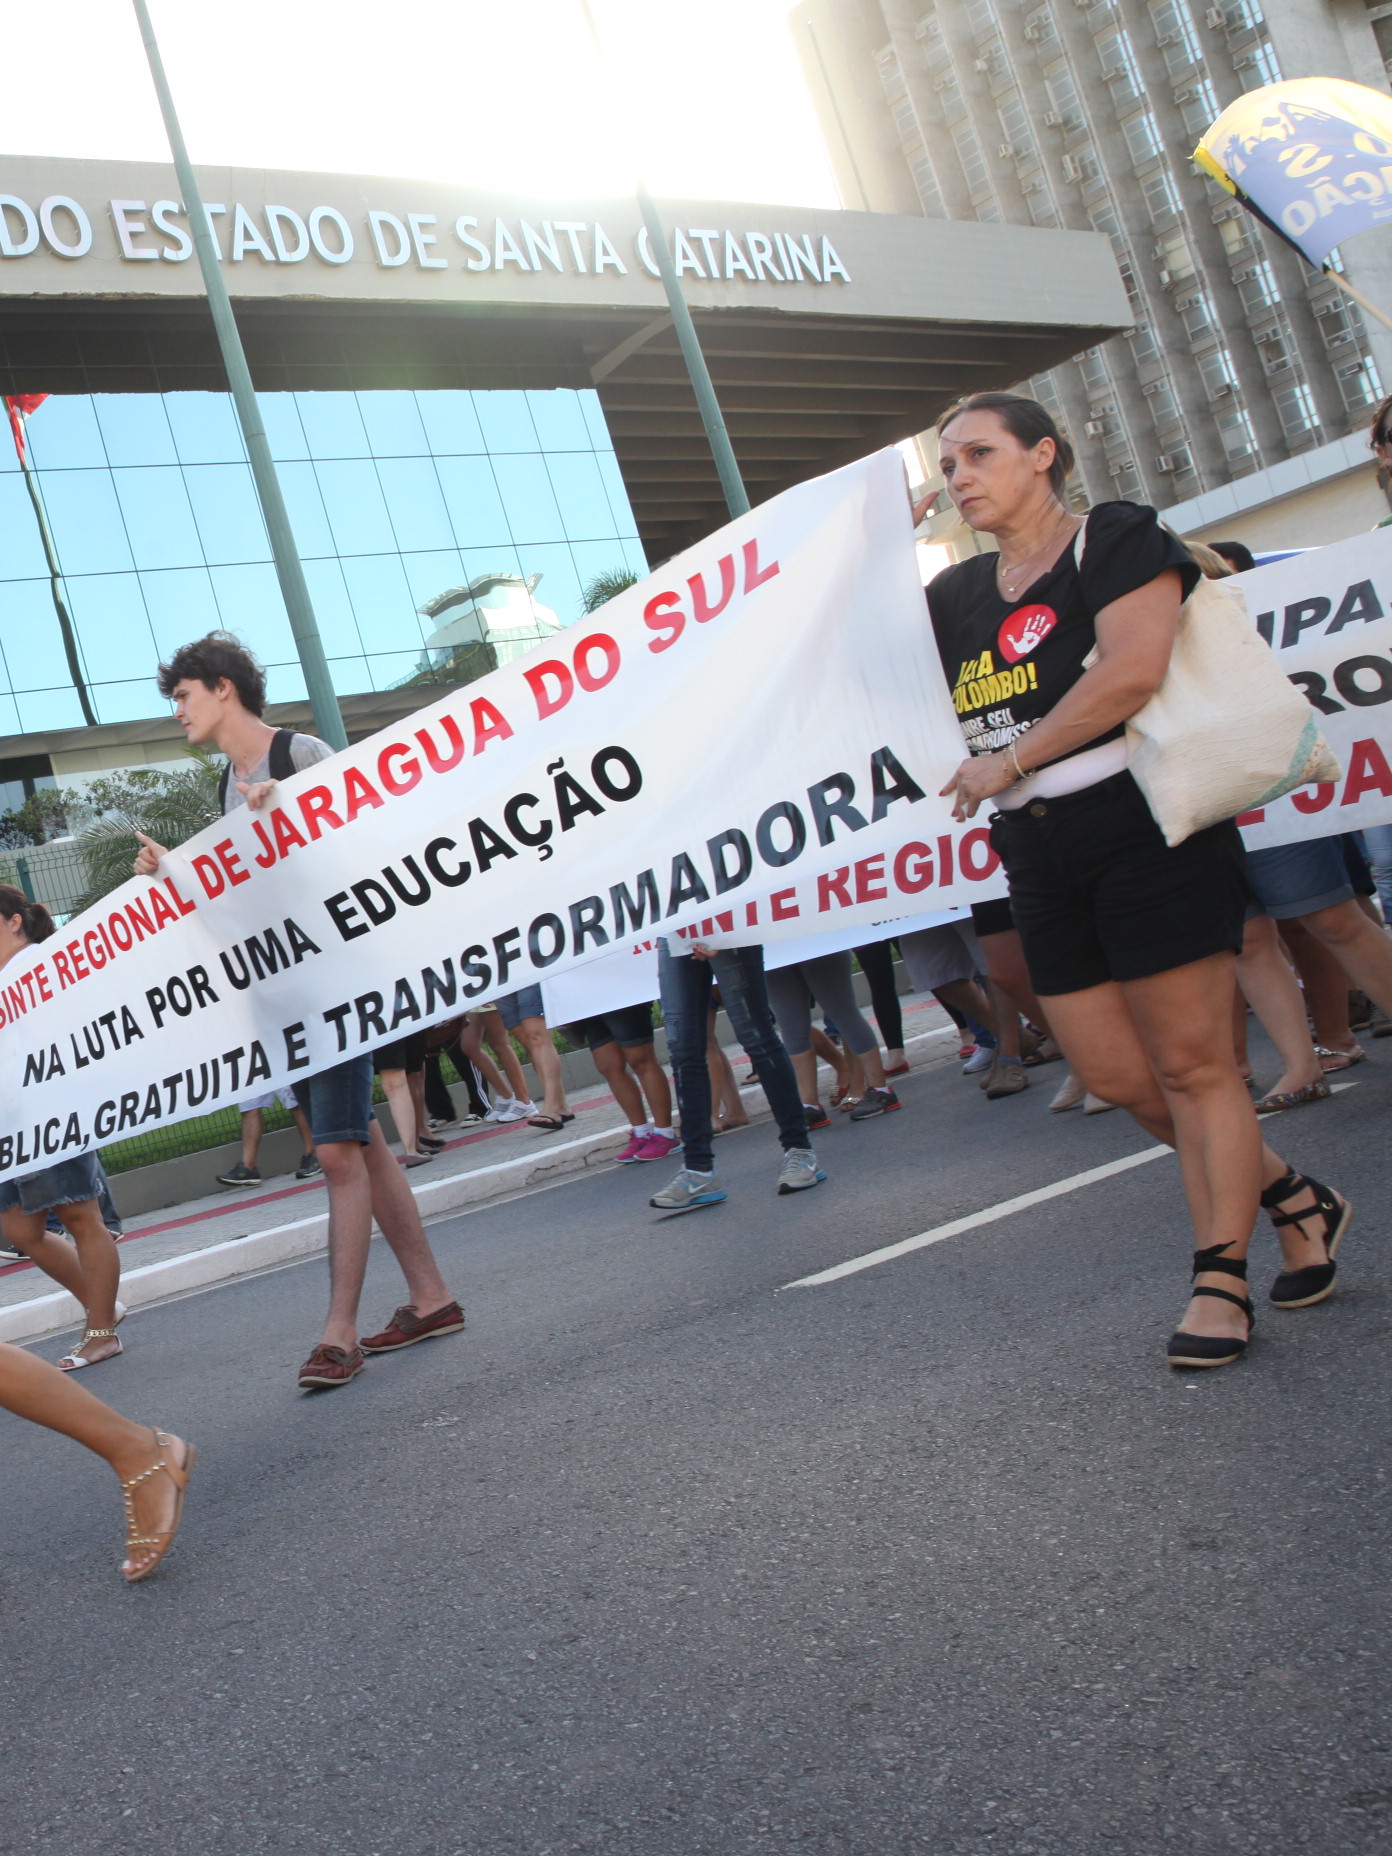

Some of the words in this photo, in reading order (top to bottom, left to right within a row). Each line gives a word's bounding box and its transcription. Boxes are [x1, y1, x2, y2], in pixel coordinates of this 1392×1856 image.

[109, 199, 354, 266] ESTADO
[367, 210, 448, 270] DE
[455, 215, 629, 275] SANTA
[637, 226, 853, 284] CATARINA
[52, 878, 196, 984] REGIONAL
[191, 838, 251, 899] DE
[254, 696, 513, 869] JARAGUA
[523, 632, 621, 720] DO
[644, 538, 780, 653] SUL
[987, 707, 1015, 729] SEU
[23, 1043, 65, 1087] NA
[71, 1005, 144, 1066] LUTA
[145, 965, 220, 1030] POR
[219, 917, 322, 990] UMA
[323, 745, 643, 941] EDUCAÇÃO
[282, 1021, 310, 1072] E
[323, 745, 926, 1052] TRANSFORMADORA
